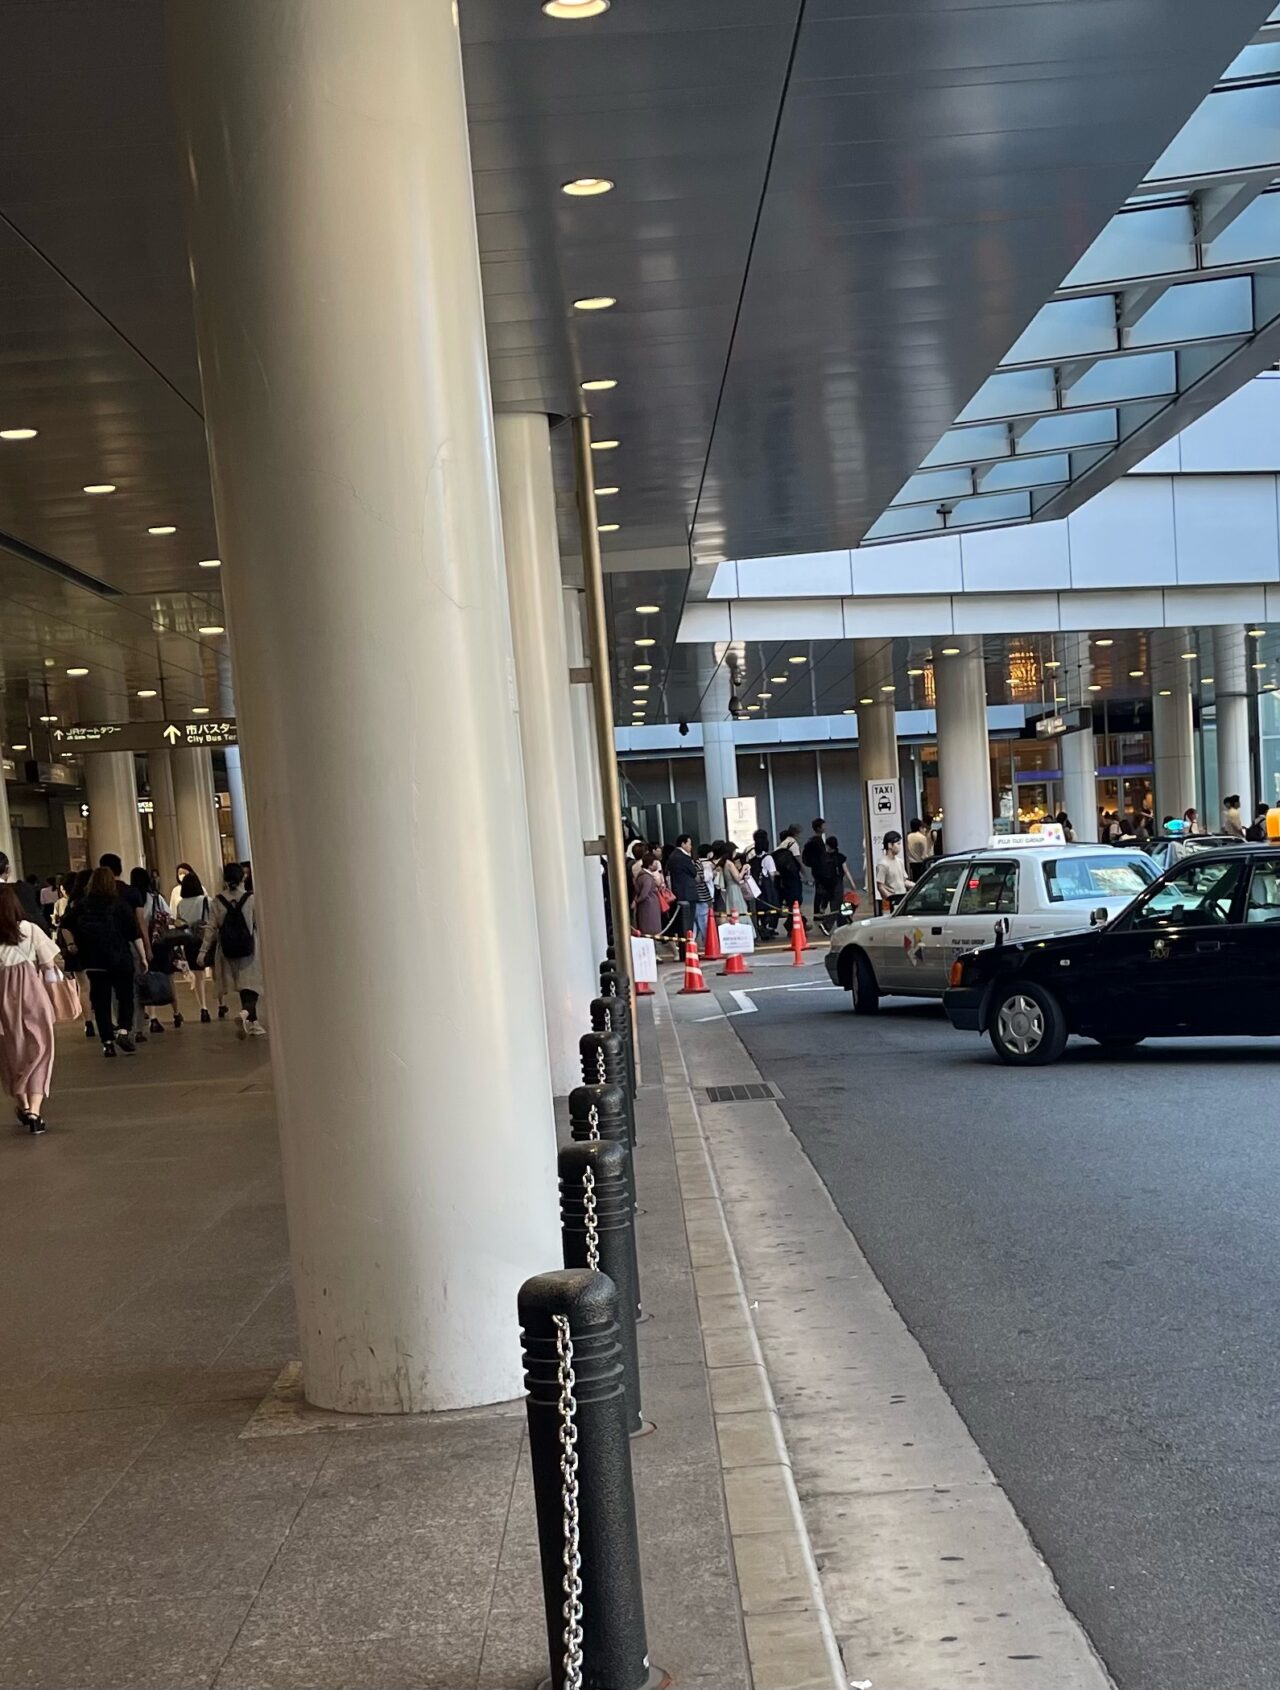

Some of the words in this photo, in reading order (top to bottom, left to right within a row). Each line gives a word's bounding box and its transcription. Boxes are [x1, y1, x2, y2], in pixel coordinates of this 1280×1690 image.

[66, 726, 121, 736] JRゲートタワー
[187, 735, 204, 744] City
[205, 734, 222, 742] Bus
[874, 786, 893, 795] TAXI
[1149, 948, 1170, 960] TAXI
